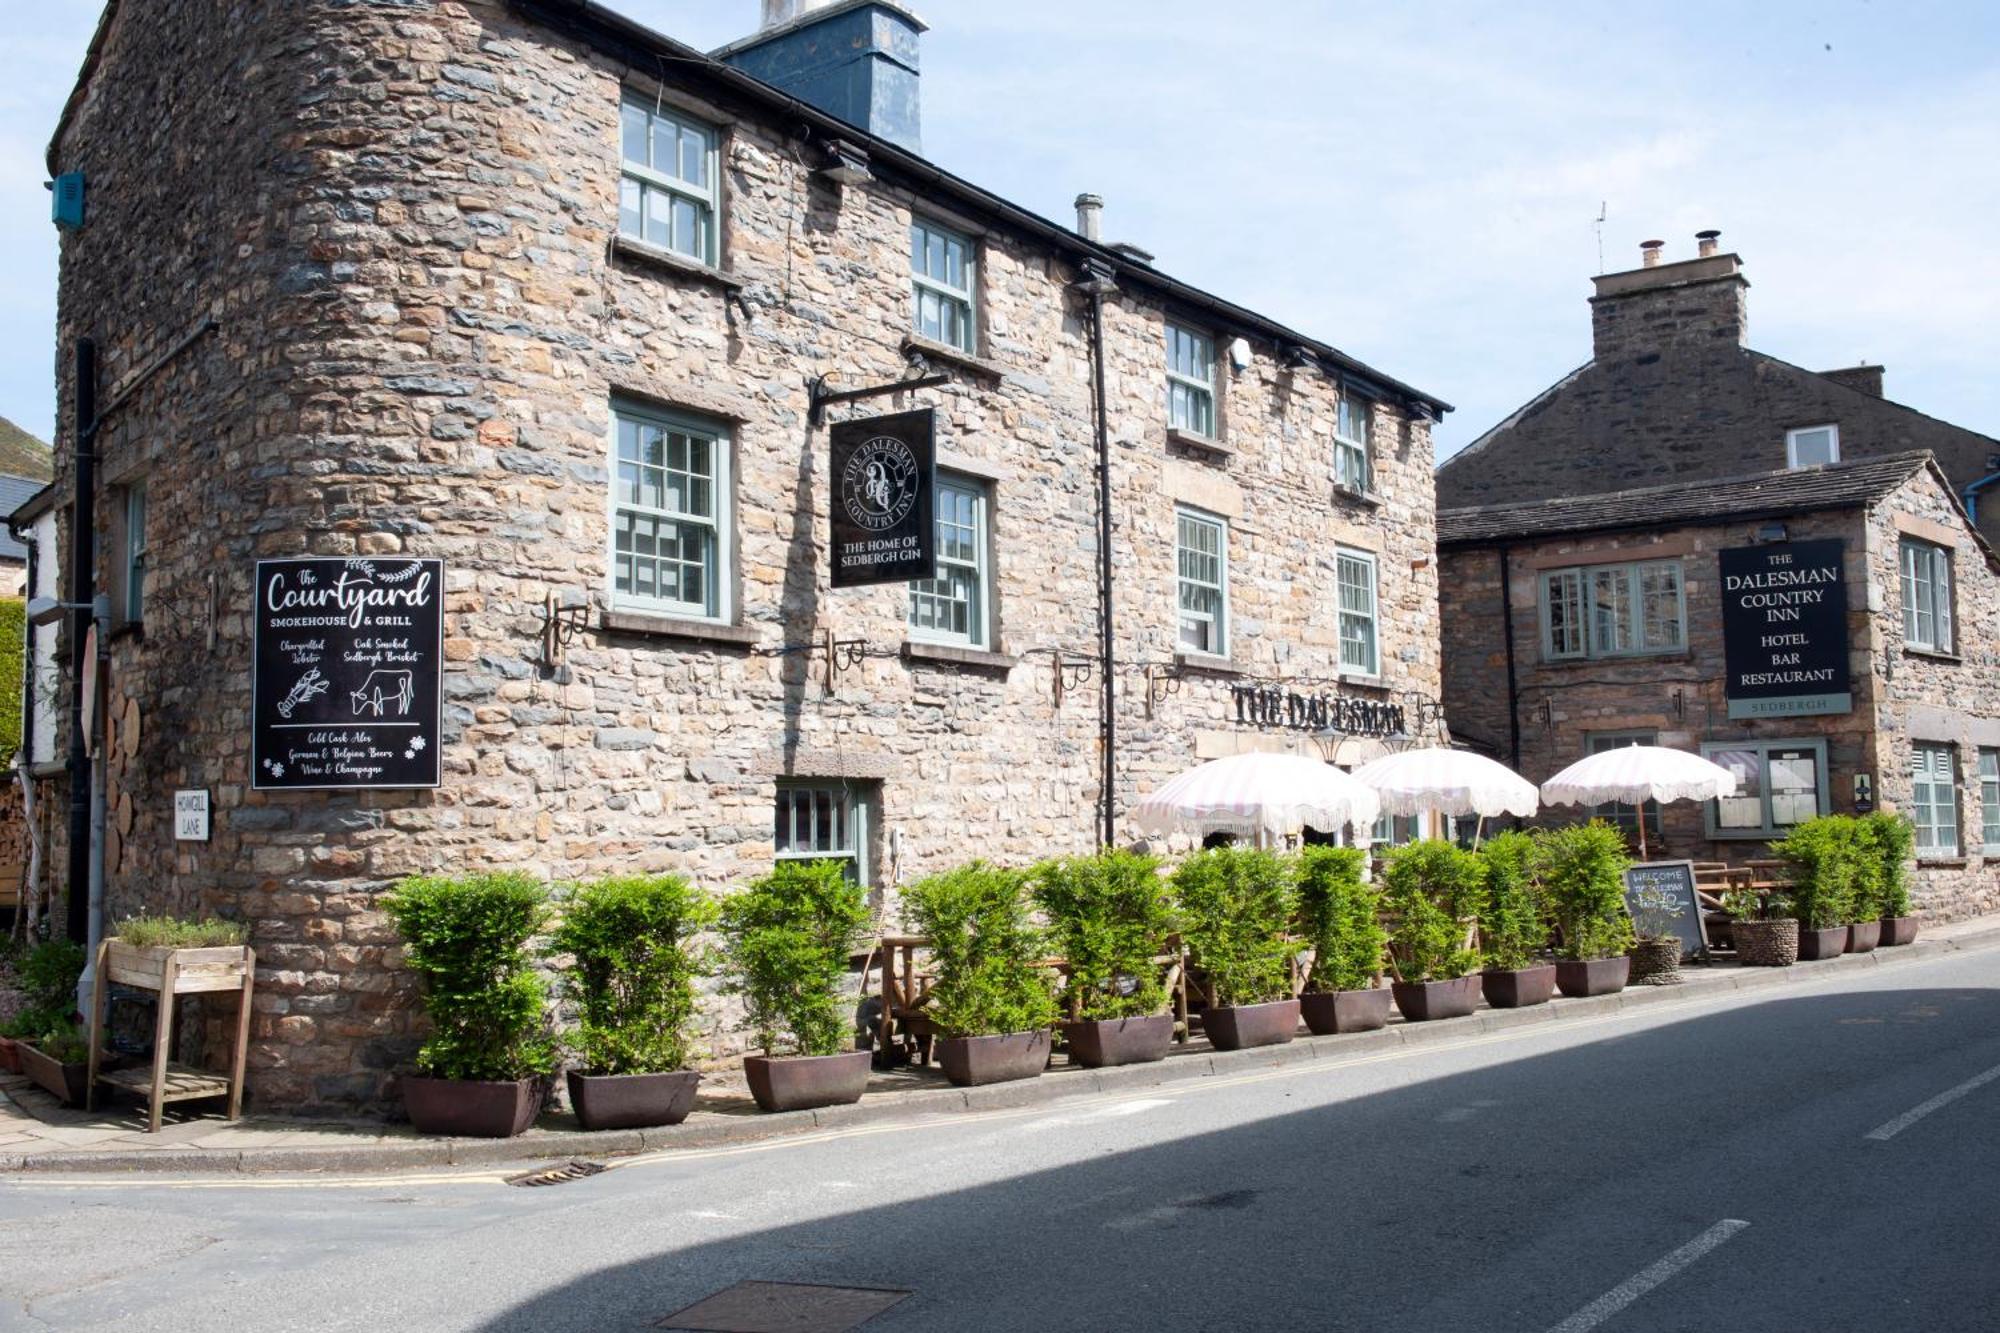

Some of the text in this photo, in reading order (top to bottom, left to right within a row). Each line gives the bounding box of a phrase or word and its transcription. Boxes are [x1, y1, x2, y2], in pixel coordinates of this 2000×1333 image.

[846, 439, 917, 484] THE DALESMAN
[847, 490, 914, 529] COUNTRY INN
[843, 536, 918, 555] THE HOME OF
[841, 548, 921, 567] SEDBERGH GIN
[1768, 554, 1793, 566] THE
[298, 569, 318, 586] the
[1726, 567, 1838, 591] DALESMAN
[268, 571, 432, 629] Courtyard
[1740, 590, 1824, 609] COUNTRY
[270, 616, 412, 628] SMOKEHOUSE & GRILL
[1767, 608, 1800, 622] INN
[280, 639, 326, 654] Chargrilled
[354, 638, 409, 650] Oak Smoked
[1761, 634, 1810, 648] HOTEL
[292, 653, 321, 664] Lobster
[344, 652, 424, 667] Sedbergh Brisket
[1772, 653, 1801, 666] BAR
[1741, 669, 1835, 686] RESTAURANT
[1231, 684, 1406, 738] THE DALESMAN
[1751, 700, 1827, 713] SEDBERGH
[307, 732, 372, 744] Cold Cask Ales
[289, 748, 394, 764] German & Belgian Beers
[301, 762, 384, 778] Wine & Champagne
[177, 795, 206, 811] HOWGILL
[182, 818, 200, 835] LANE
[1632, 870, 1684, 882] WELCOME
